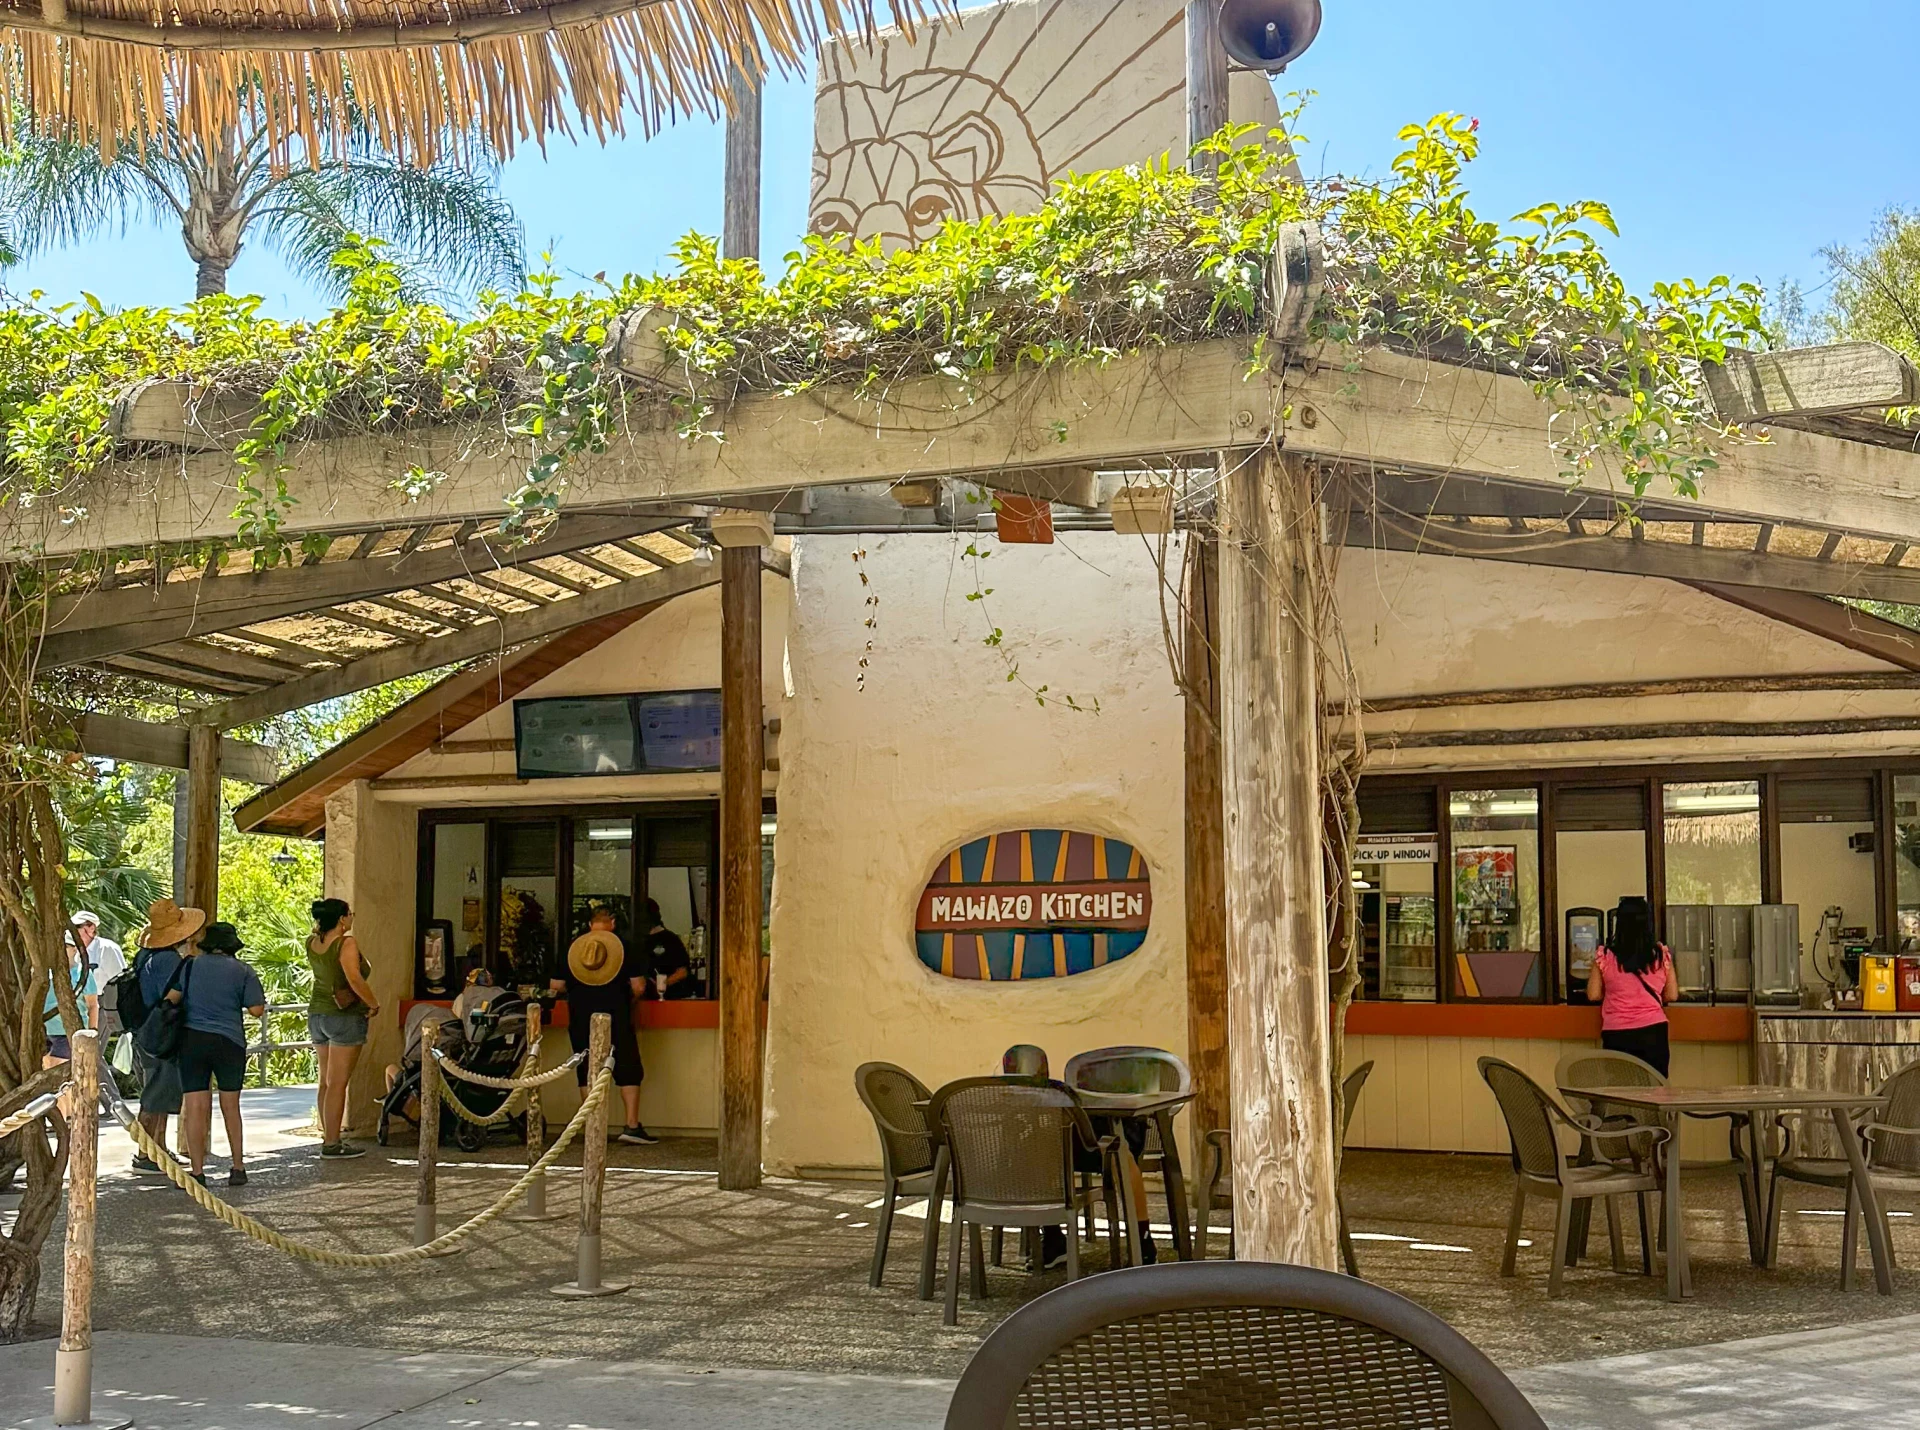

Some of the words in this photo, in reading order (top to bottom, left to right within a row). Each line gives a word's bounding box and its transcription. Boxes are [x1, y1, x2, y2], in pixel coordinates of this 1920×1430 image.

[1394, 849, 1431, 859] WINDOW
[468, 866, 477, 883] A
[931, 894, 1033, 922] MAWAZO
[1041, 892, 1143, 920] KITCHEN
